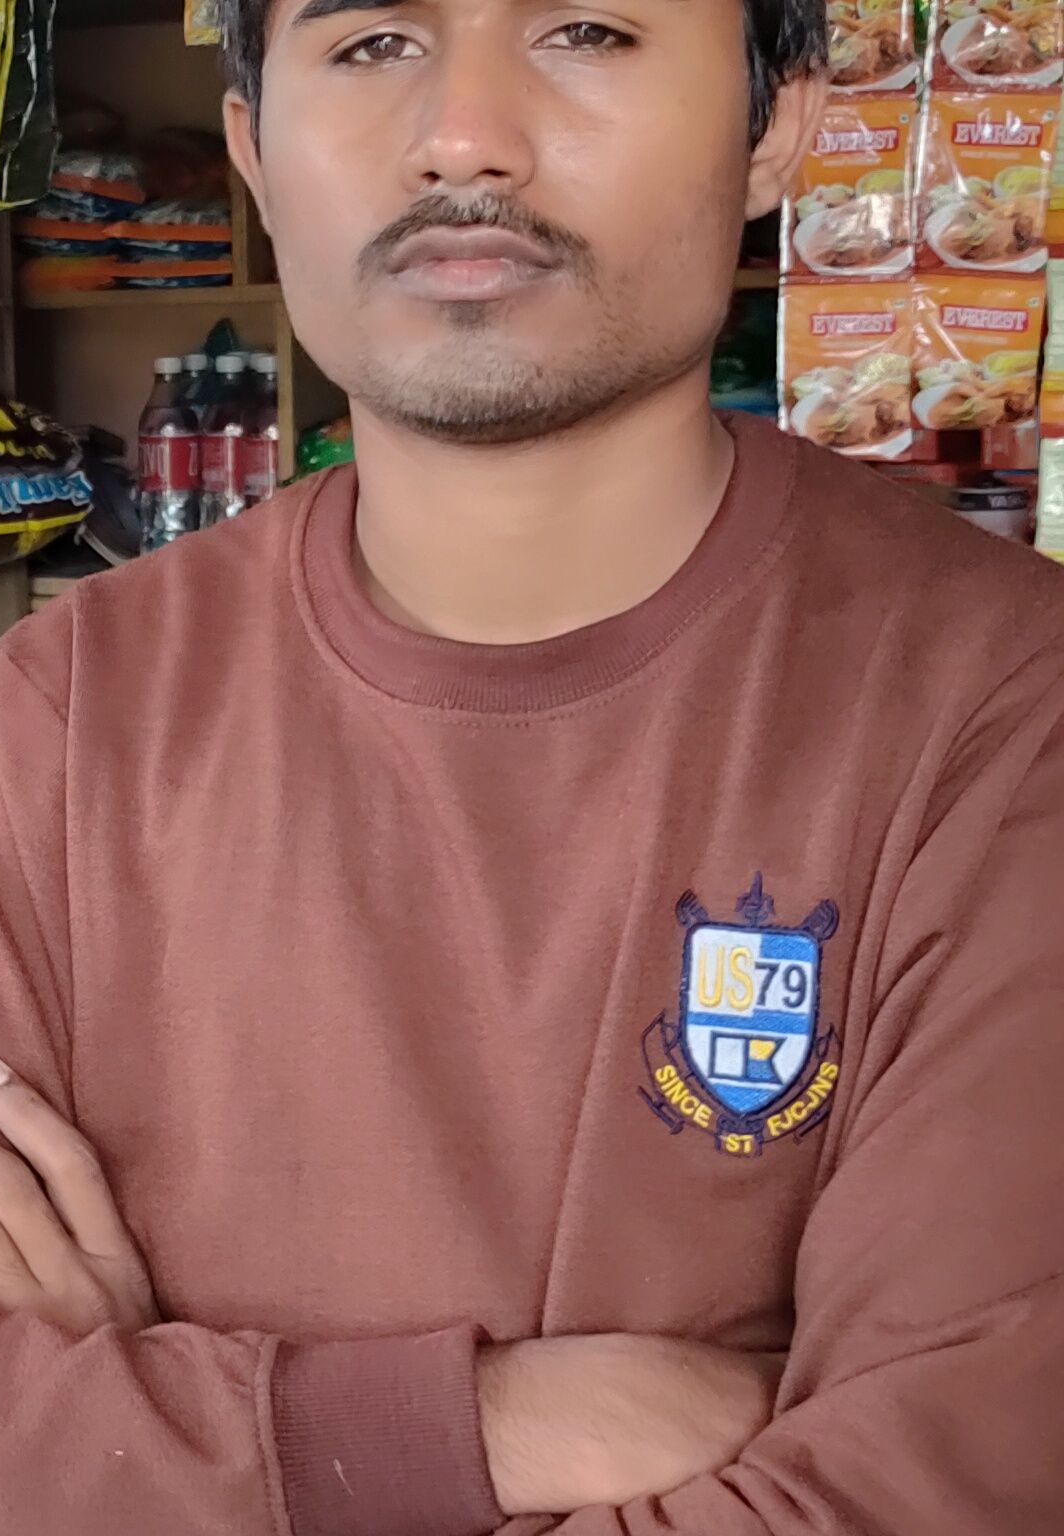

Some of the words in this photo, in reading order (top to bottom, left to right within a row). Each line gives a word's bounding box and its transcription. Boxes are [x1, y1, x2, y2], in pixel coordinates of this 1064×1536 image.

[954, 120, 1042, 148] EVEREST
[811, 312, 895, 336] EVEREST
[941, 304, 1028, 333] EVEREST
[654, 1063, 714, 1129] SINCE
[720, 1132, 755, 1155] ST
